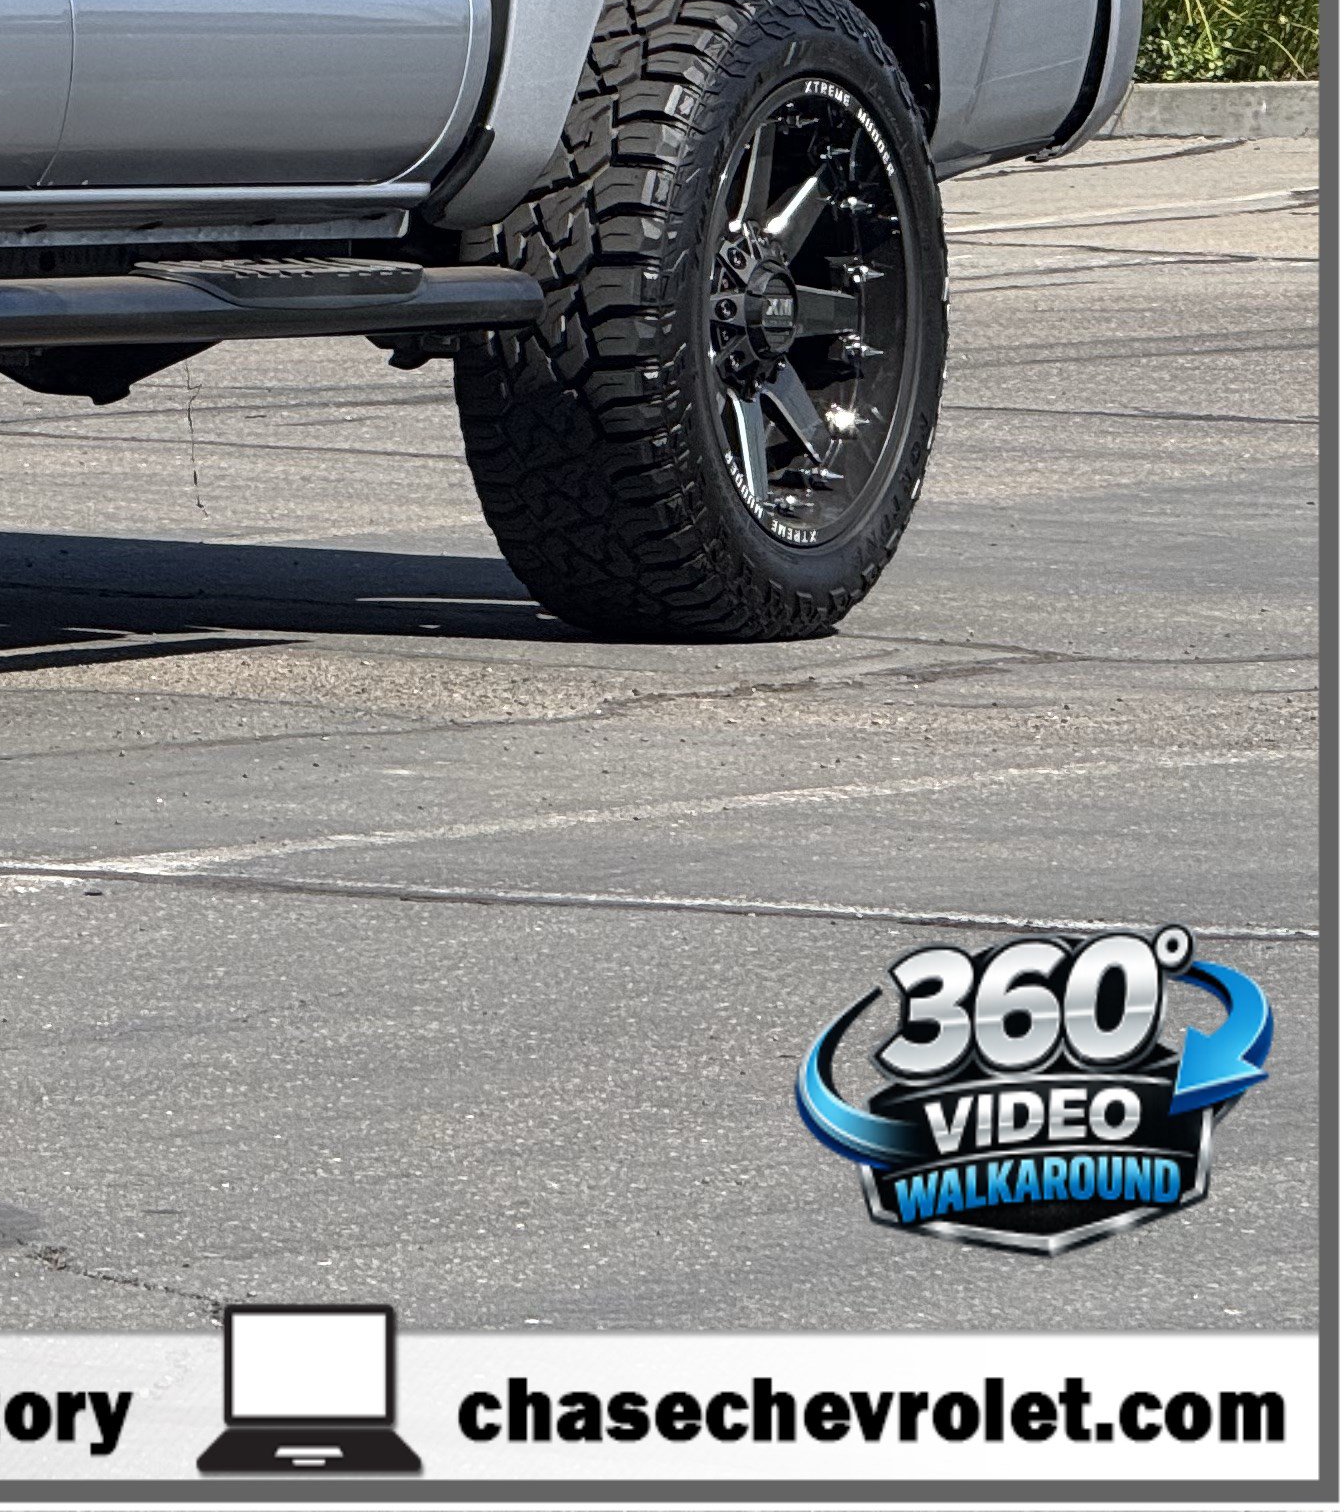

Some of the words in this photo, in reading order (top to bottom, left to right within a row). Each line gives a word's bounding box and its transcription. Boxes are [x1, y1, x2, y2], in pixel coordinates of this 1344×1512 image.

[804, 80, 851, 107] XTREME
[856, 107, 895, 177] MUDDER
[771, 519, 818, 544] XTREME
